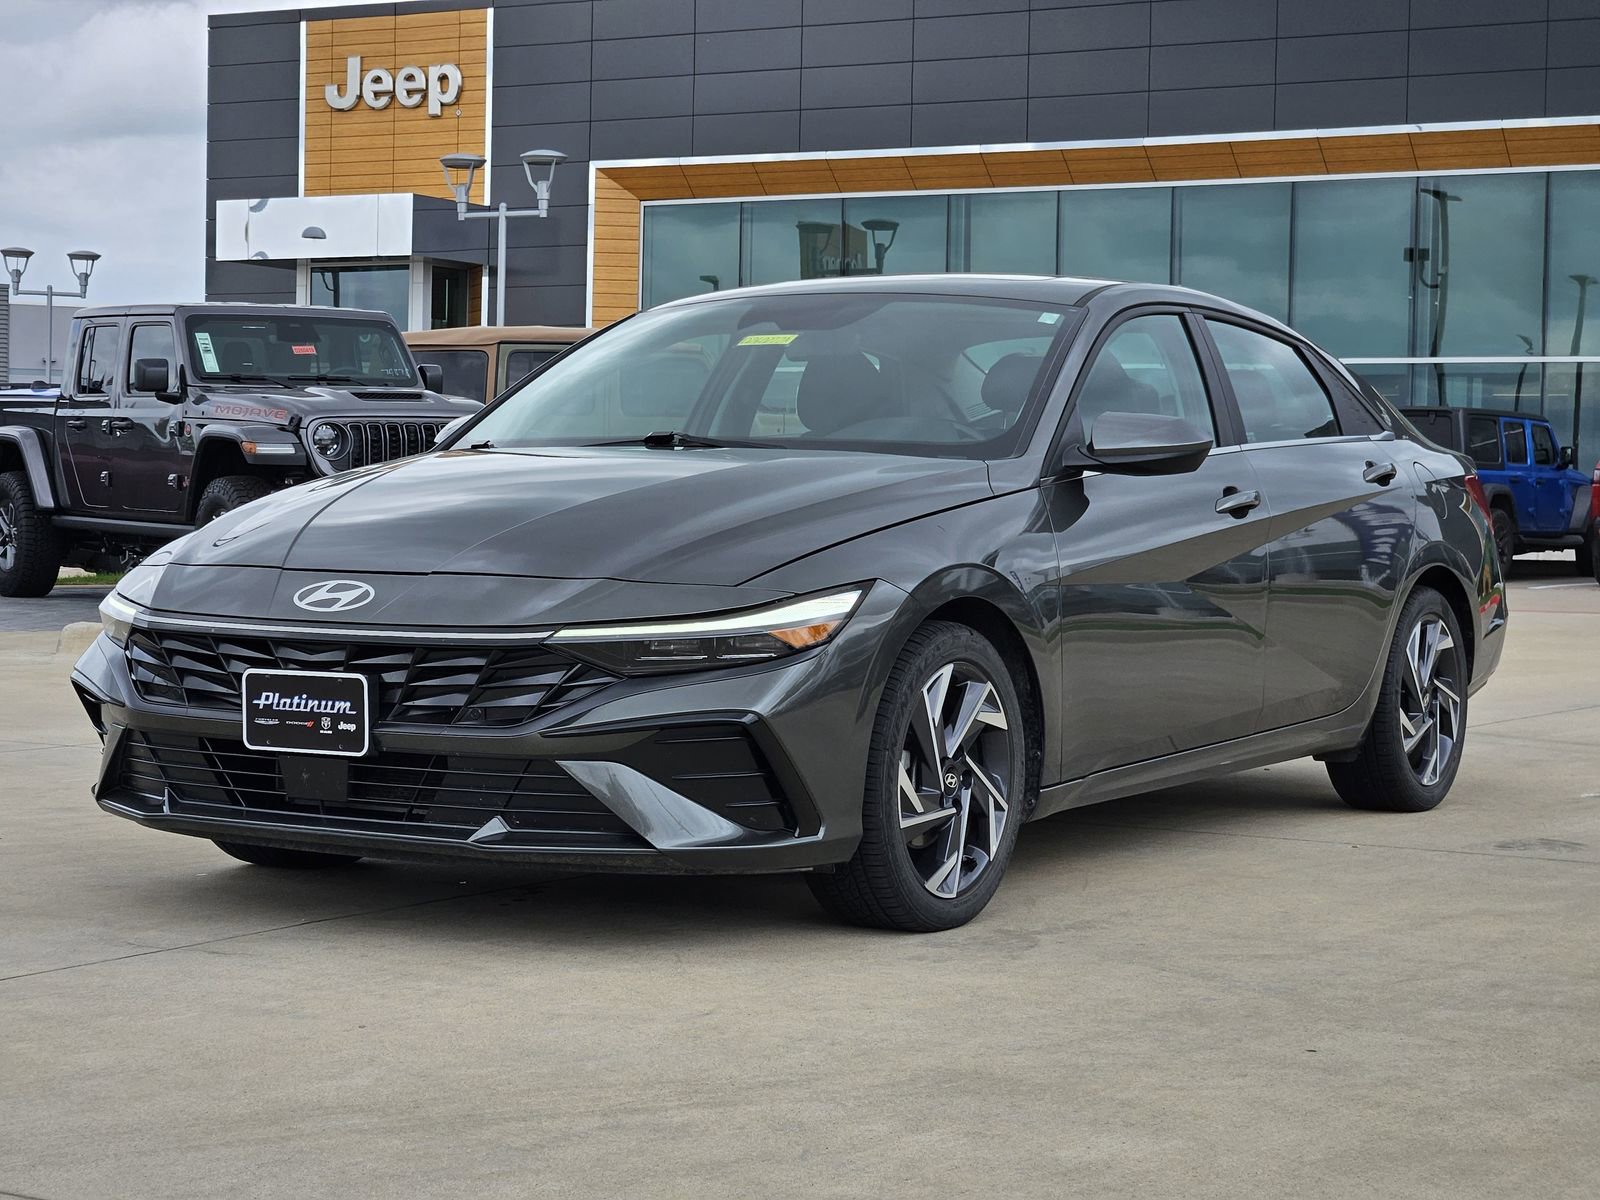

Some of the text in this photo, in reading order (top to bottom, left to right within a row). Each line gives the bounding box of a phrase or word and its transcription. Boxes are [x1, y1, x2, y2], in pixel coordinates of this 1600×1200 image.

[324, 55, 463, 117] Jeep
[215, 405, 288, 419] MOJAVE
[252, 691, 357, 714] Platinum
[337, 721, 357, 732] Jeep
